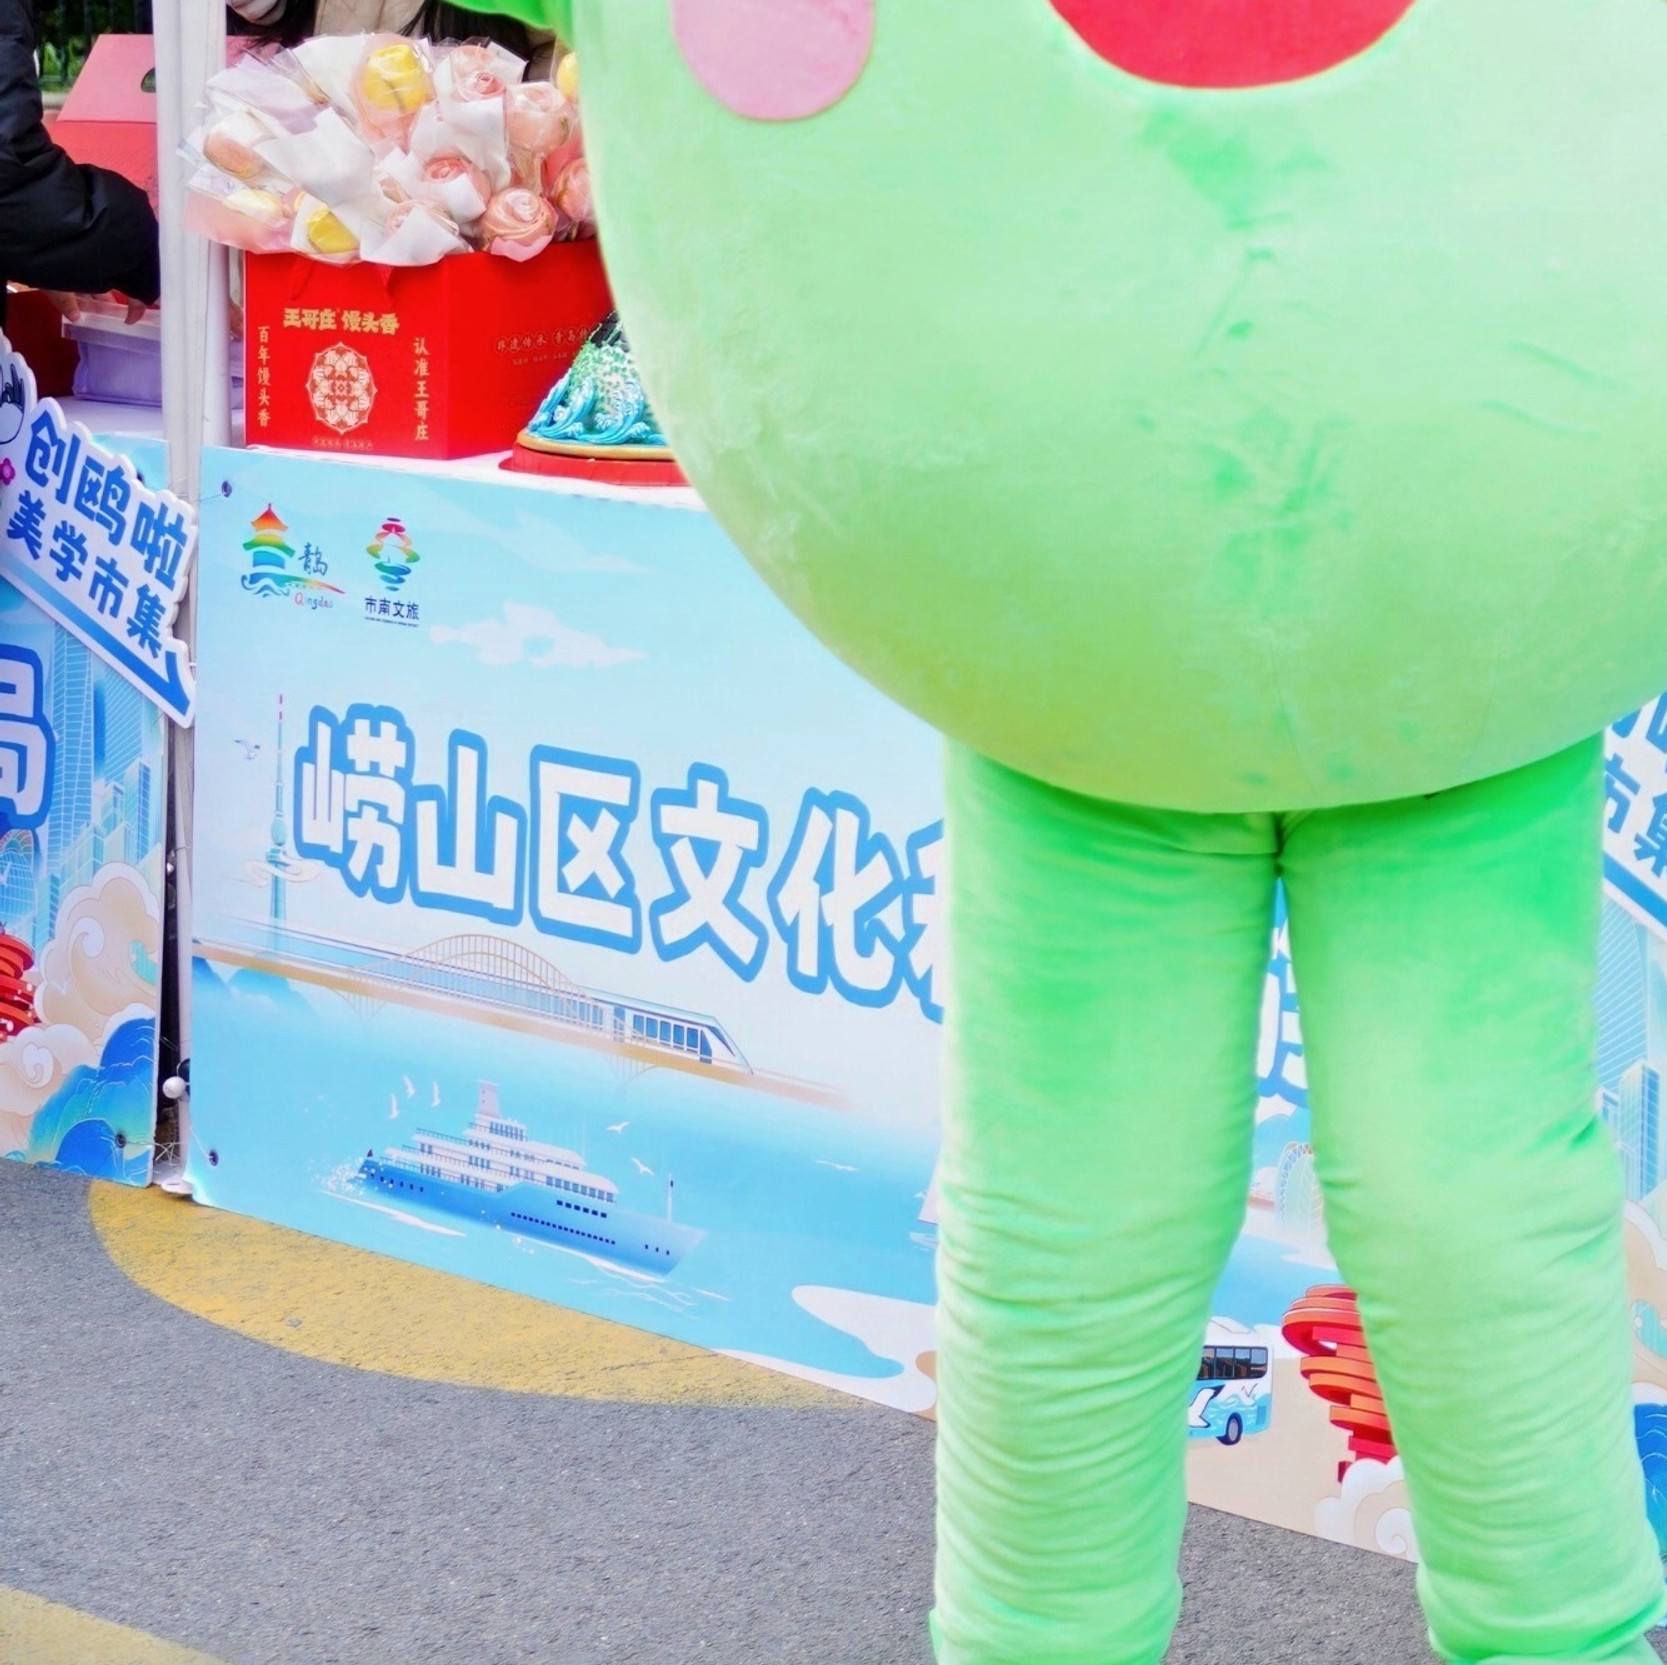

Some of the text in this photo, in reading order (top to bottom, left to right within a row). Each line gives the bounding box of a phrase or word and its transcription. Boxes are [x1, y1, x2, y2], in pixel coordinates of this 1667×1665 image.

[283, 307, 400, 336] 王哥庄 馒头香
[257, 326, 271, 428] 百年馒头香
[413, 337, 430, 441] 认准王哥庄
[24, 410, 188, 591] 创鸥啦
[6, 490, 168, 660] 美学市集
[298, 542, 328, 576] 青岛
[294, 591, 334, 610] Qingdao
[364, 596, 420, 621] 市南文旅
